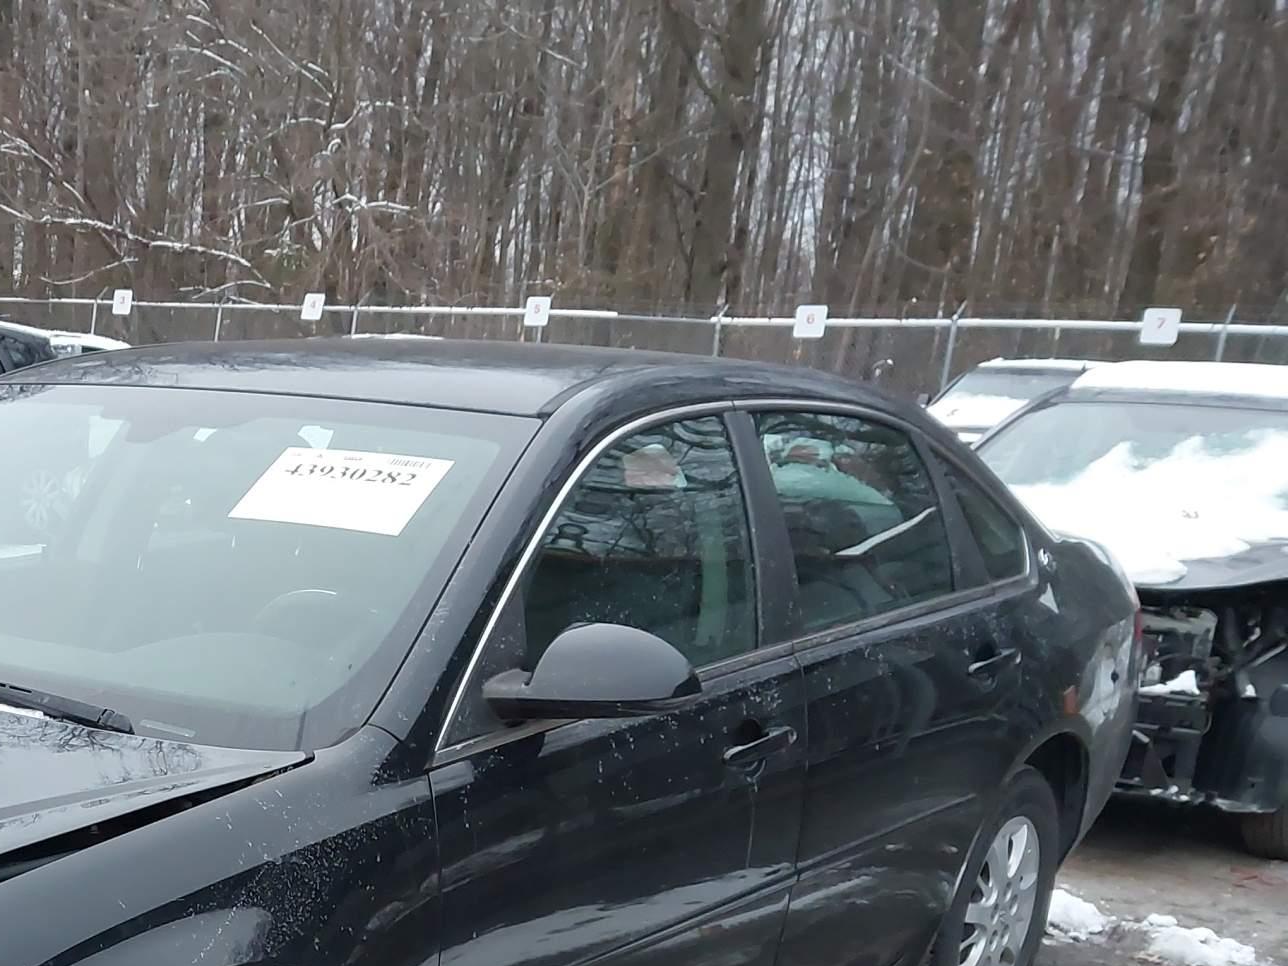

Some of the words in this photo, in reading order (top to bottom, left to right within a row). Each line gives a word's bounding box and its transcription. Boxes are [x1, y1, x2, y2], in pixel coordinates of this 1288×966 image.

[119, 295, 126, 305] 3
[310, 300, 317, 310] 4
[533, 303, 541, 315] 5
[805, 313, 815, 325] 6
[1156, 317, 1167, 329] 7
[283, 462, 418, 487] 43930282
